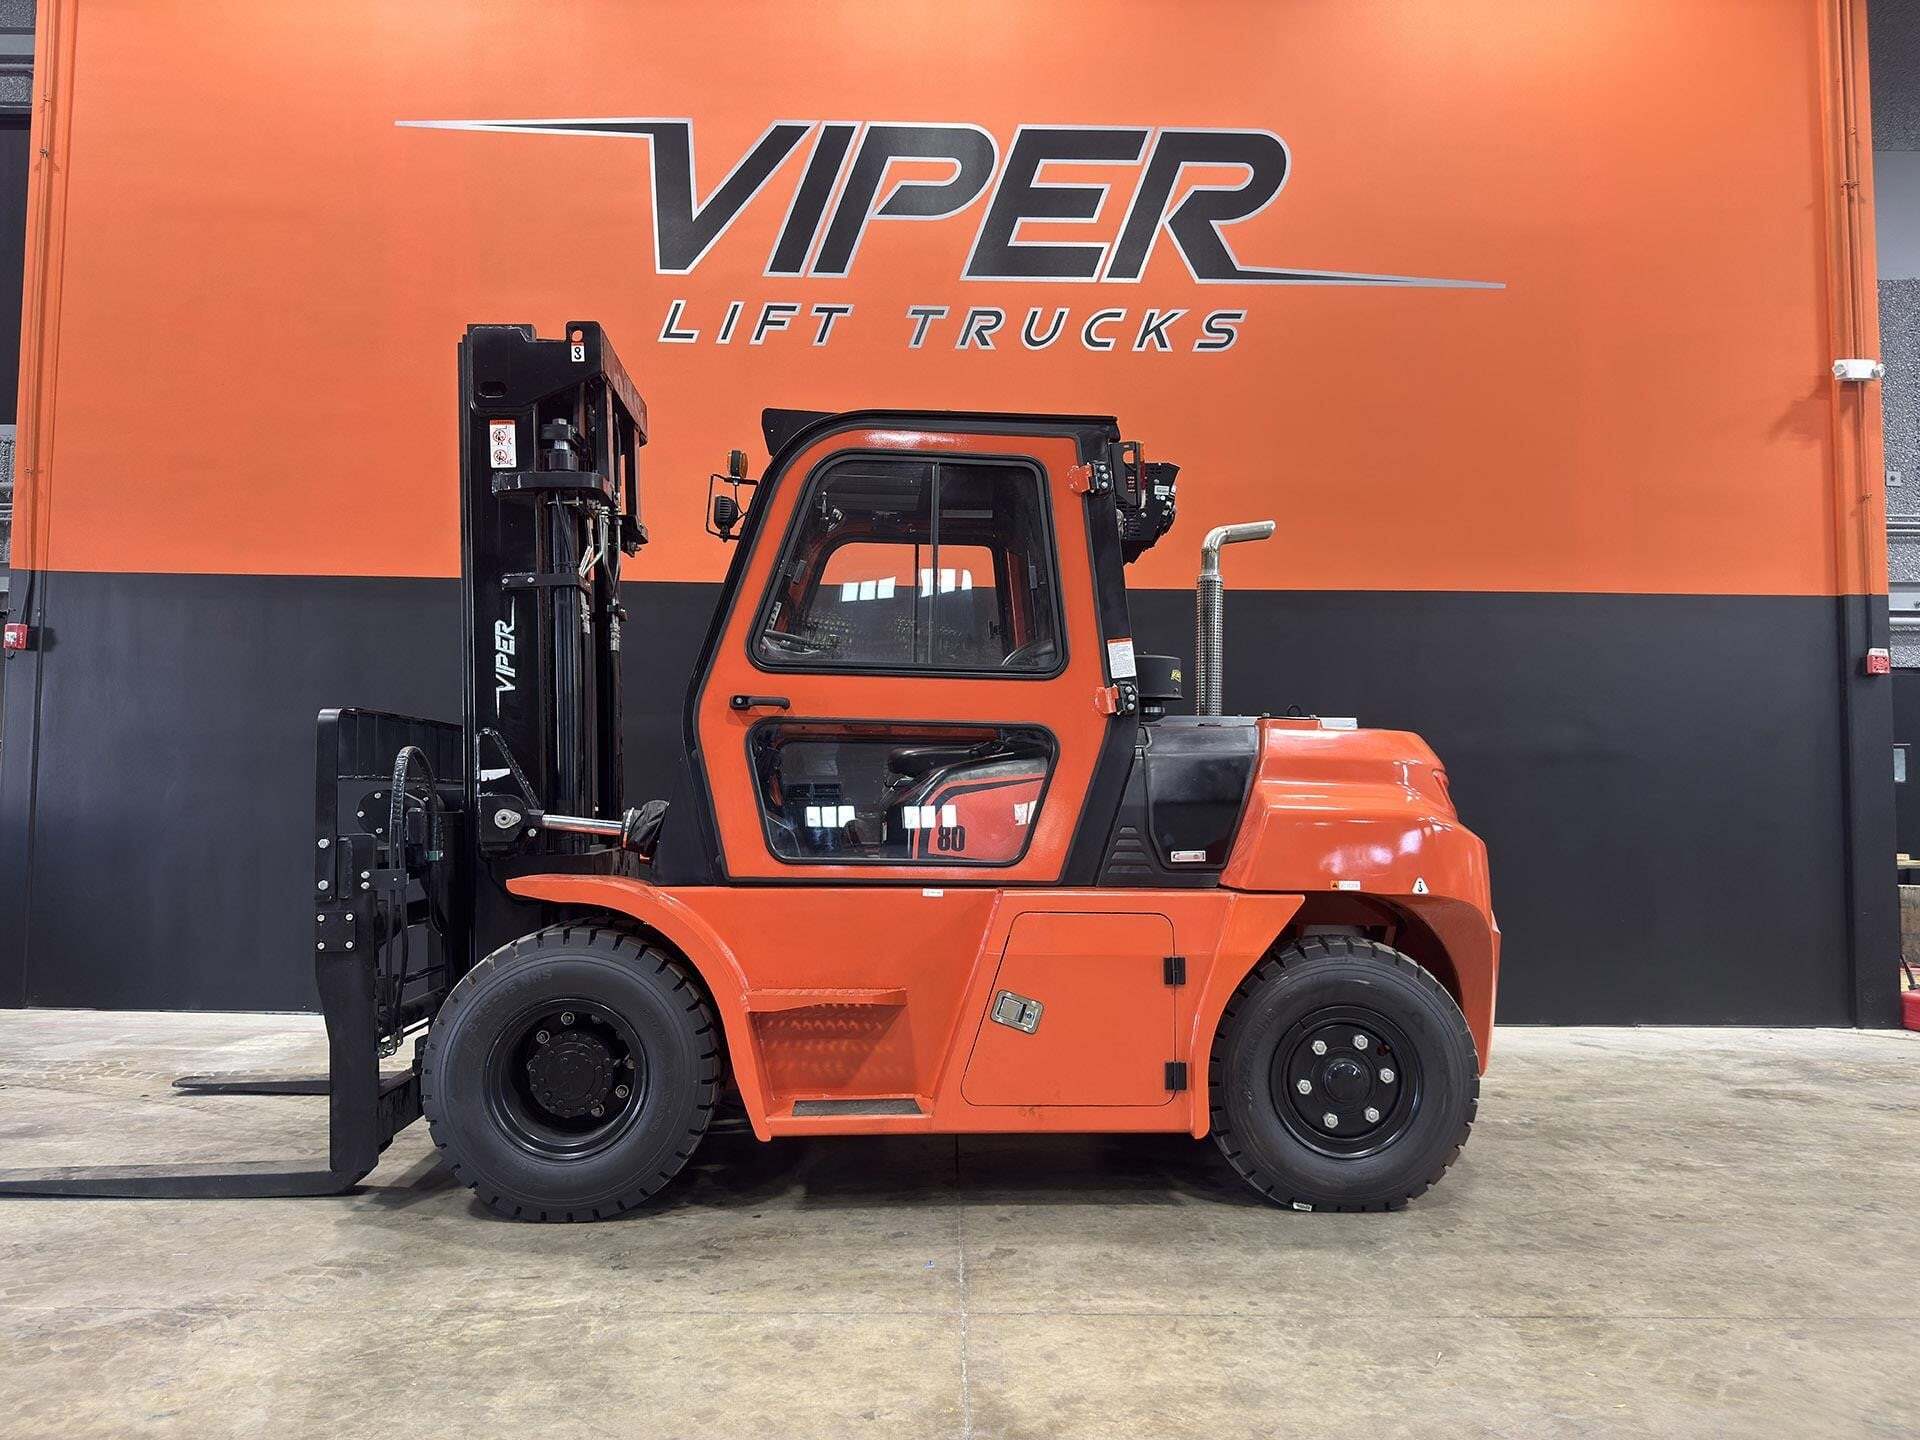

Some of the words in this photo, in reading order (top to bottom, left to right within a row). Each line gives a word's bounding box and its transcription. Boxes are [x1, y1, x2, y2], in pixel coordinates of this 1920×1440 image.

[394, 117, 1506, 290] VIPER
[657, 298, 854, 347] LIFT
[906, 304, 1248, 353] TRUCKS
[494, 596, 516, 718] VIPER
[938, 824, 965, 851] 80
